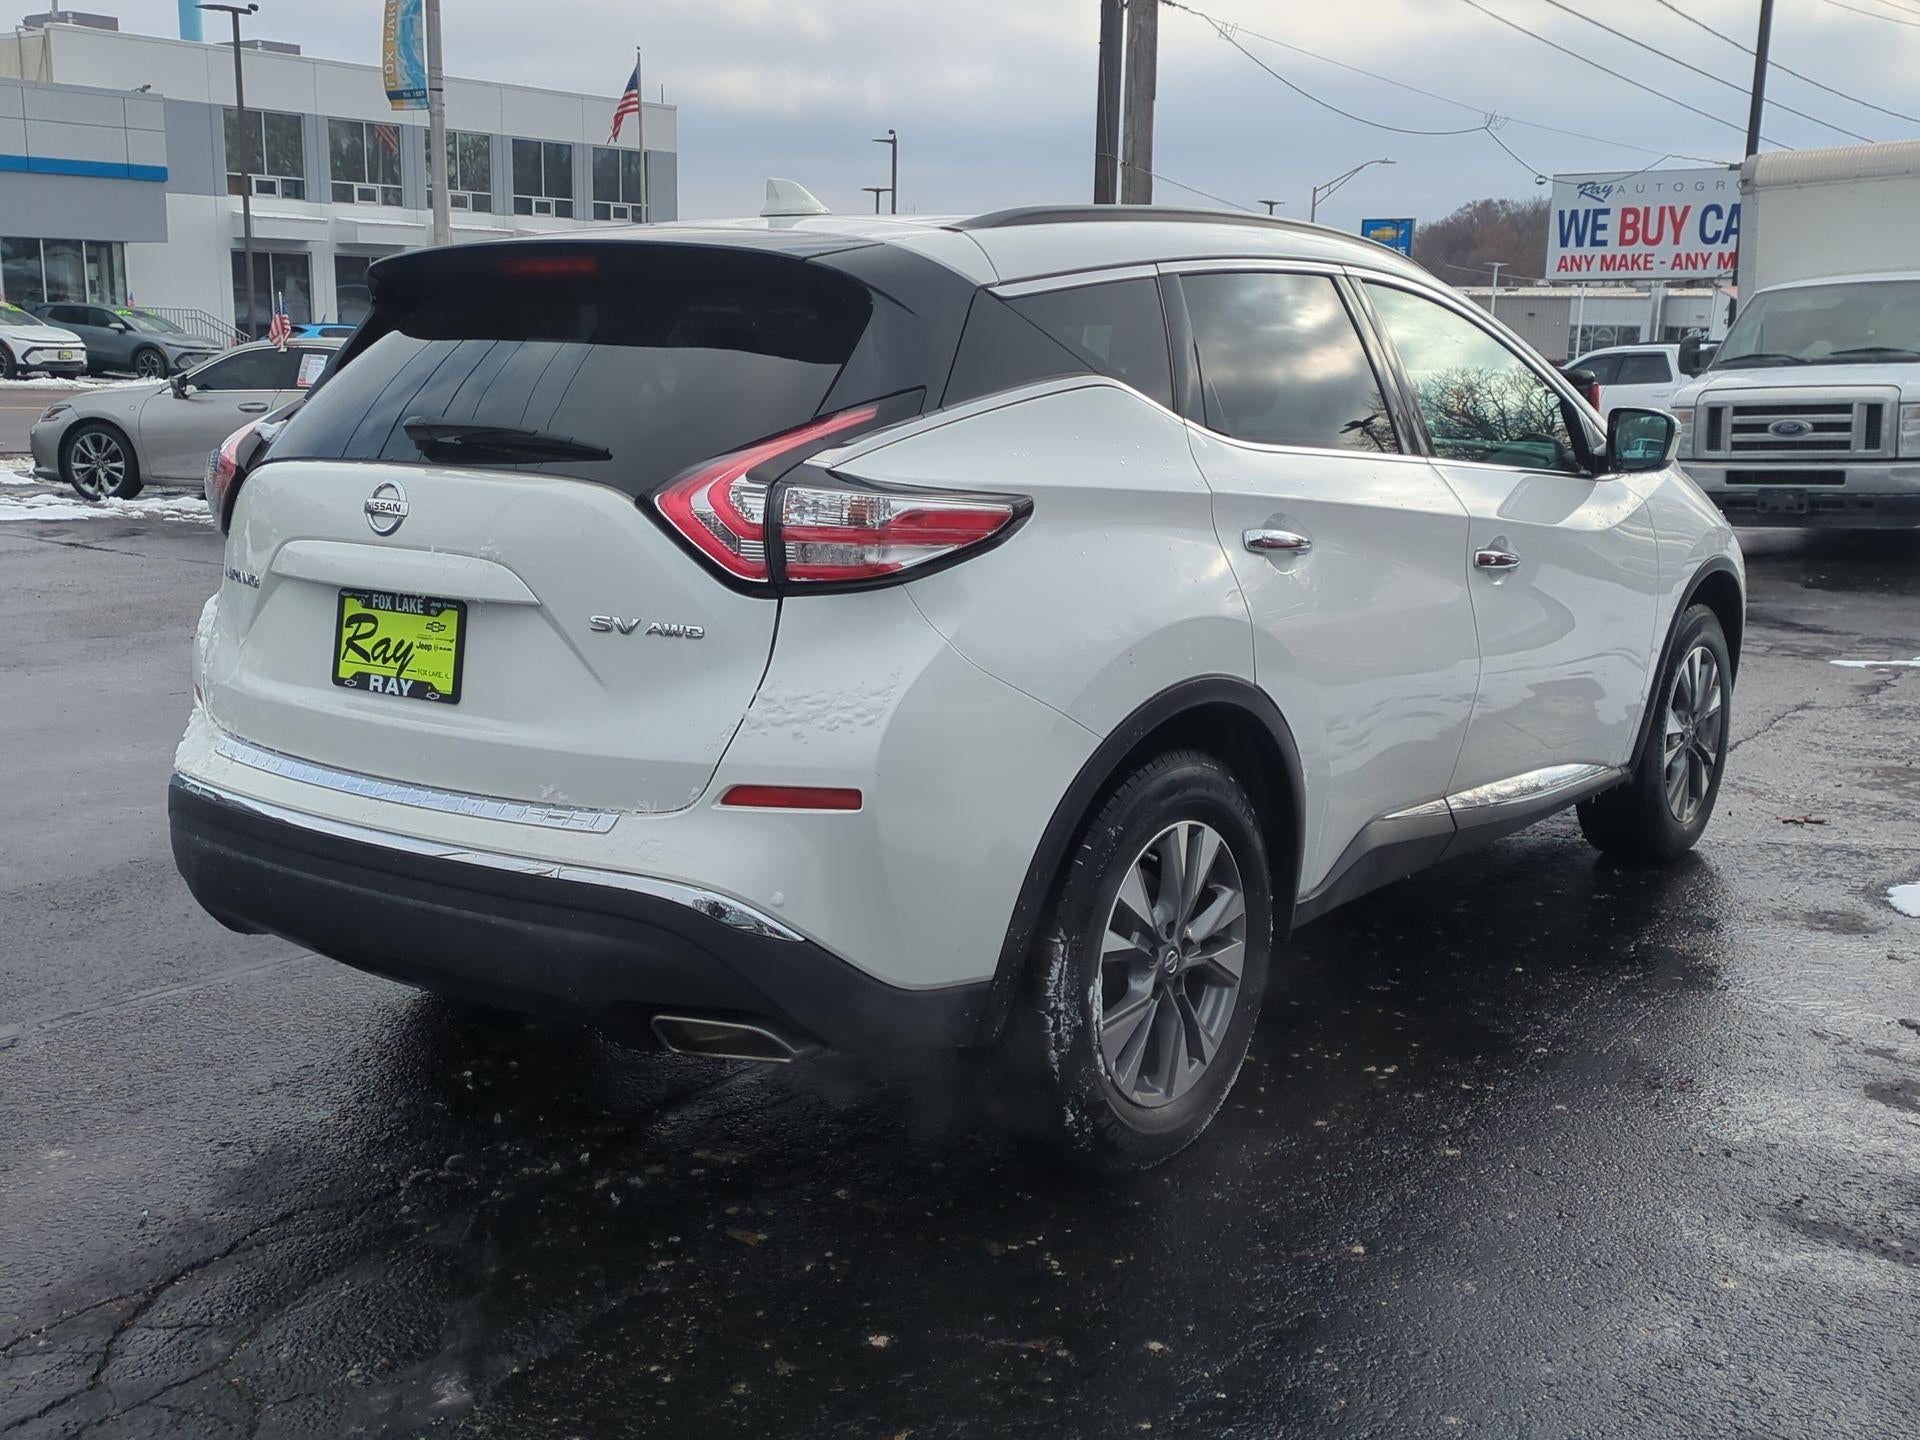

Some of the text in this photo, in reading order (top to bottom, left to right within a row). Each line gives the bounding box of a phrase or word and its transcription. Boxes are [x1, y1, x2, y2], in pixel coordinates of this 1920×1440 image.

[384, 48, 394, 86] FOX
[1576, 181, 1614, 203] Ray
[1558, 207, 1611, 248] WE
[1618, 204, 1692, 247] BUY
[1557, 254, 1595, 272] ANY
[1600, 253, 1655, 272] MAKE
[1670, 252, 1713, 270] ANY
[367, 500, 401, 513] NISSAN
[372, 594, 424, 614] FOX LAKE
[589, 614, 705, 640] SV AWD
[341, 612, 415, 678] Ray
[368, 674, 414, 697] RAY
